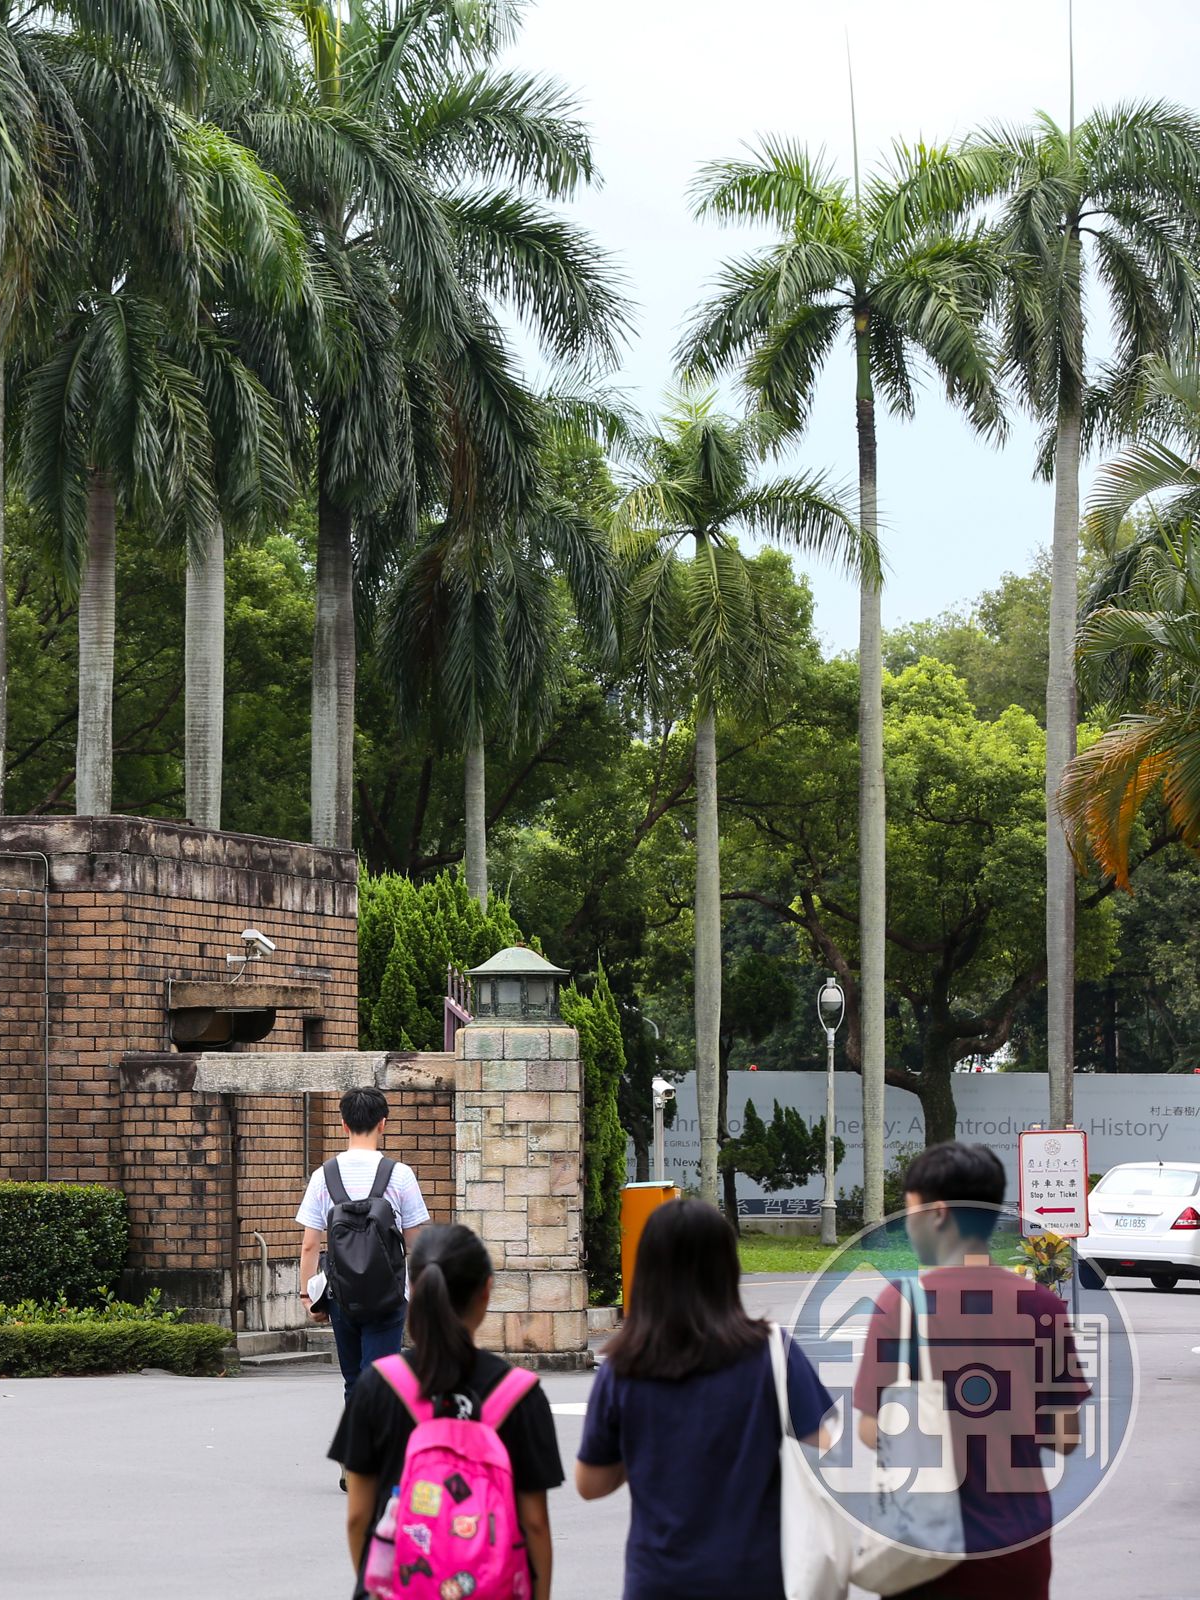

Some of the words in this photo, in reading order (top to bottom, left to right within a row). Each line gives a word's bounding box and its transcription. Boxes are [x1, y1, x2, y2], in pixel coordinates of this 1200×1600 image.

[1090, 1117, 1169, 1142] History
[1031, 1179, 1077, 1188] 停車取票
[1030, 1191, 1044, 1199] Stop
